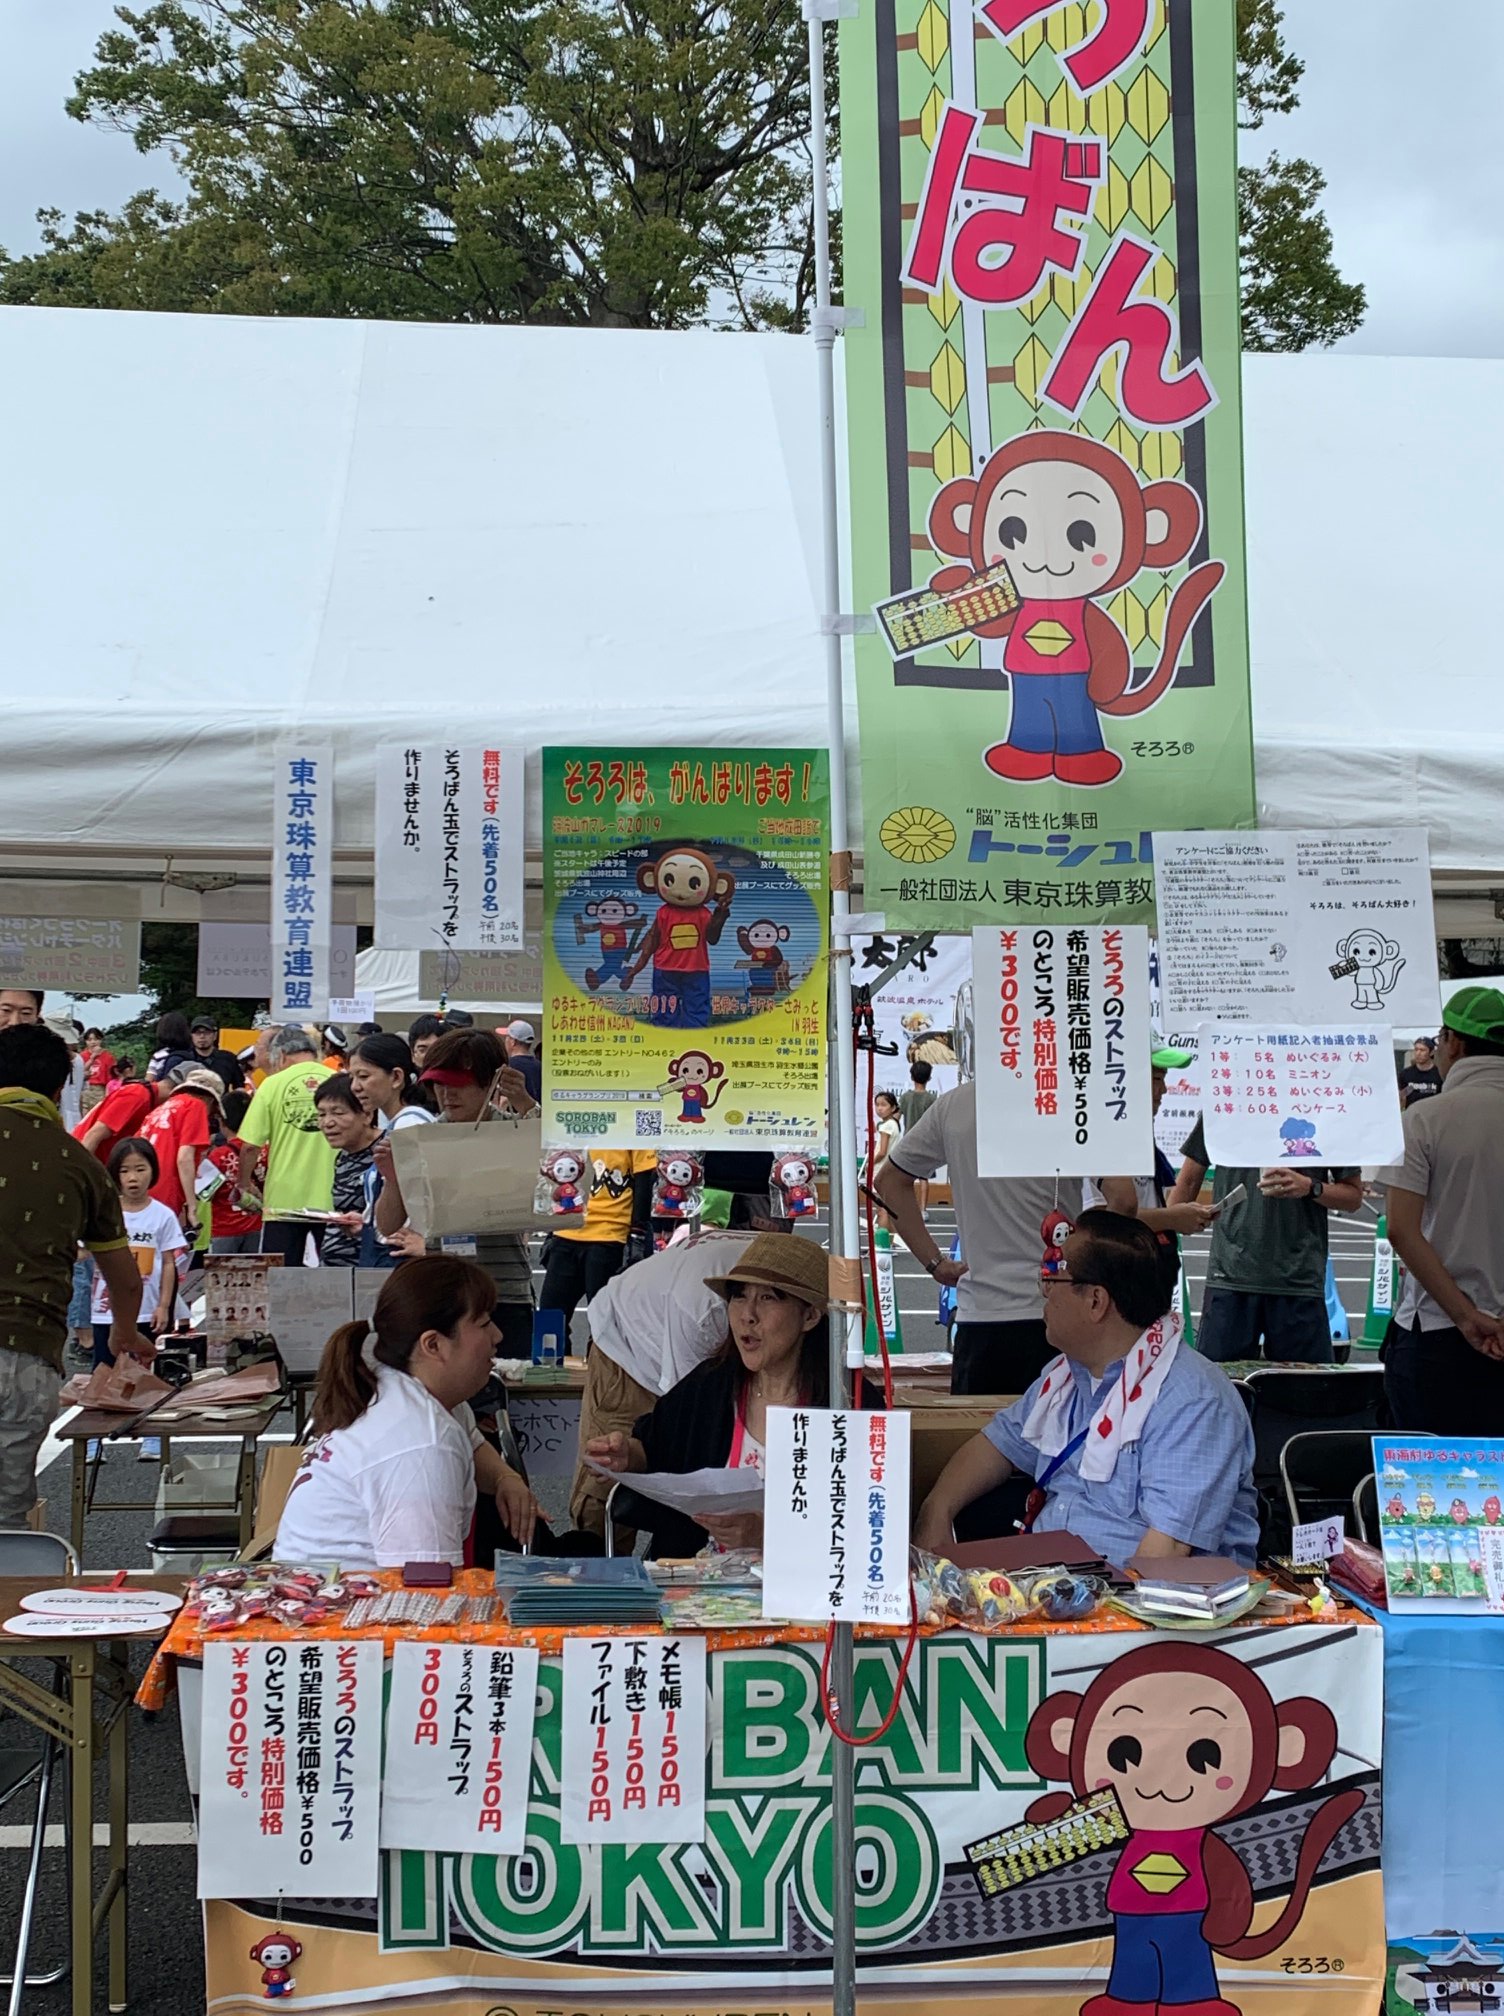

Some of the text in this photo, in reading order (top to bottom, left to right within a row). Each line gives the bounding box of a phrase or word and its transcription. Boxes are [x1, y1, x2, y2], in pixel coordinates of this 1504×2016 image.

[403, 749, 421, 852] 作りませんか。
[442, 749, 460, 937] そろばん玉でストラップを
[481, 749, 500, 919] 無料です（先着50名）
[563, 760, 811, 805] そろろは、がんばります！
[1175, 846, 1269, 855] アンケートにご協力ください
[283, 757, 317, 1009] 東京珠算教育連盟
[880, 879, 997, 901] 一般社団法人
[1000, 930, 1022, 1079] ¥300です。
[1033, 930, 1058, 1115] のところ特別価格
[1067, 930, 1091, 1144] 希望販売価格¥500
[556, 1111, 617, 1123] SOROBAN
[564, 1122, 609, 1134] TOKYO
[746, 1116, 816, 1126] トーシュレン
[792, 1413, 809, 1519] 作りませんか。
[829, 1414, 847, 1607] そろばん玉でストラップを
[867, 1415, 887, 1590] 無料です（先着50名）
[226, 1647, 250, 1798] ¥300です。
[260, 1646, 286, 1835] のところ特別価格
[296, 1645, 323, 1866] 希望販売価格¥500
[414, 1648, 442, 1746] 300円
[448, 1648, 474, 1795] そろろのストラップ
[478, 1651, 515, 1833] 鉛筆3本150円
[588, 1642, 611, 1822] ファイル150円
[624, 1641, 647, 1810] 下敷き150円
[658, 1643, 682, 1807] メモ帳150円
